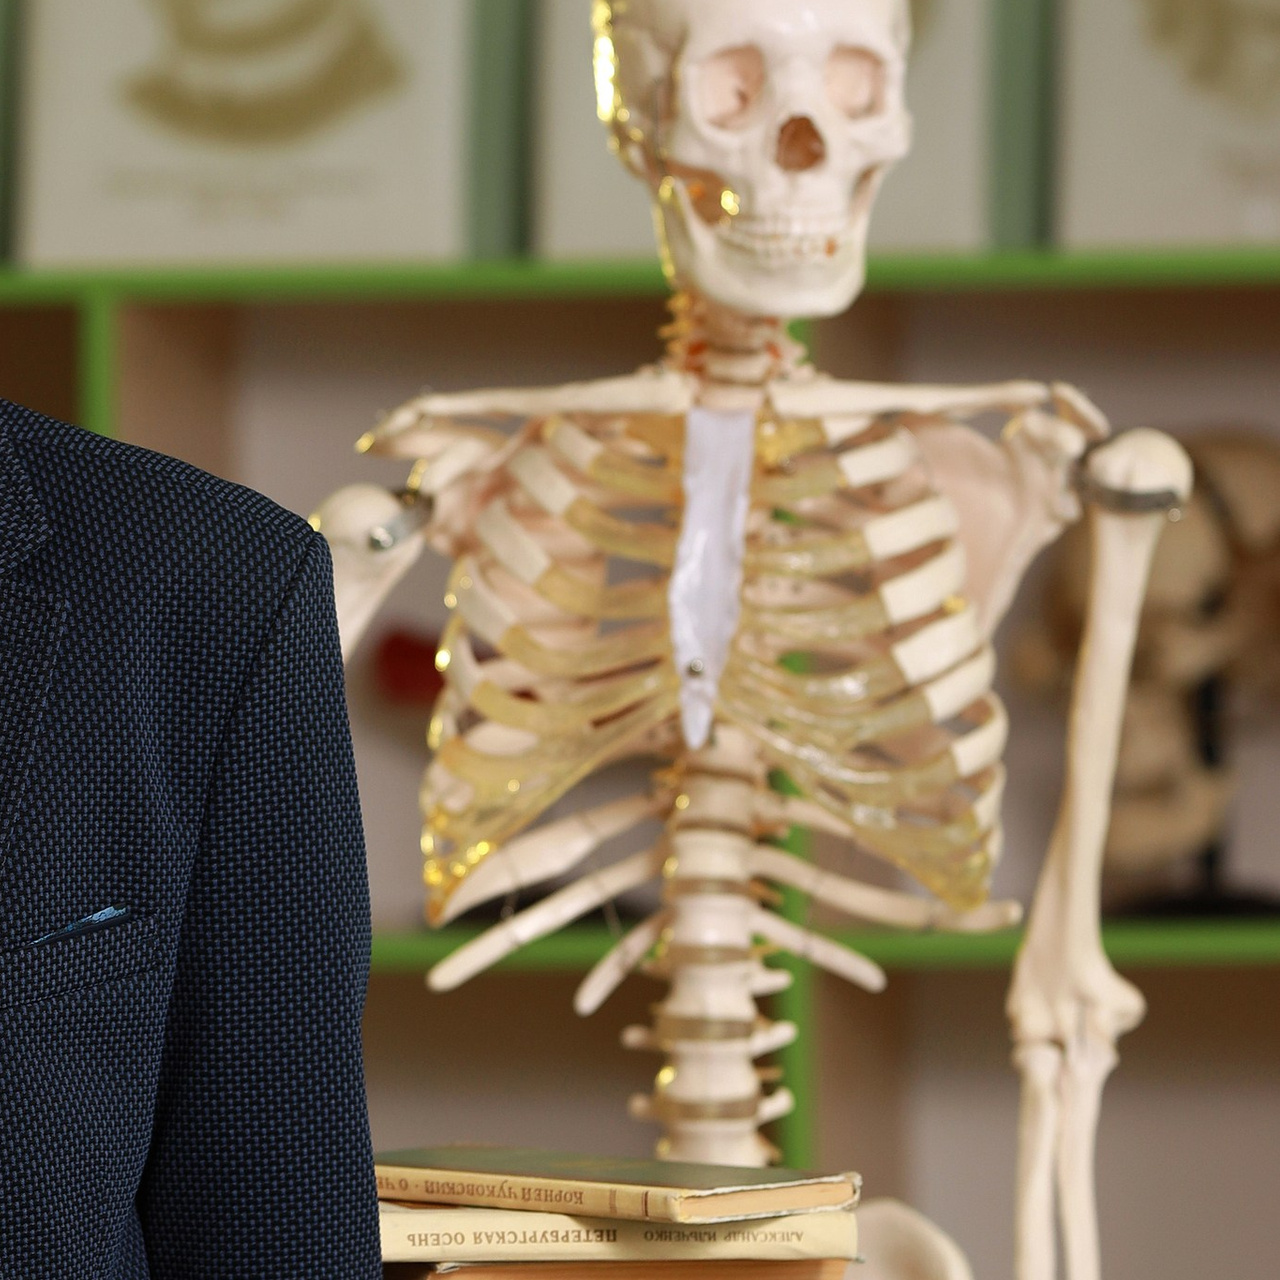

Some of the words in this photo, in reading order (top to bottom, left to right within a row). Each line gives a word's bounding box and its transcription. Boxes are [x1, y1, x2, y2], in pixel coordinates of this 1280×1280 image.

[424, 1180, 518, 1200] ЧУКОВСКИЙ
[521, 1187, 584, 1205] КОРНЕЙ
[407, 1231, 466, 1247] ОСЕНЬ
[473, 1229, 617, 1245] ПЕТЕРБУРГСКАЯ
[644, 1230, 717, 1242] ИЛЬЧЕНКО
[724, 1230, 804, 1242] АЛЕКСАНДР
